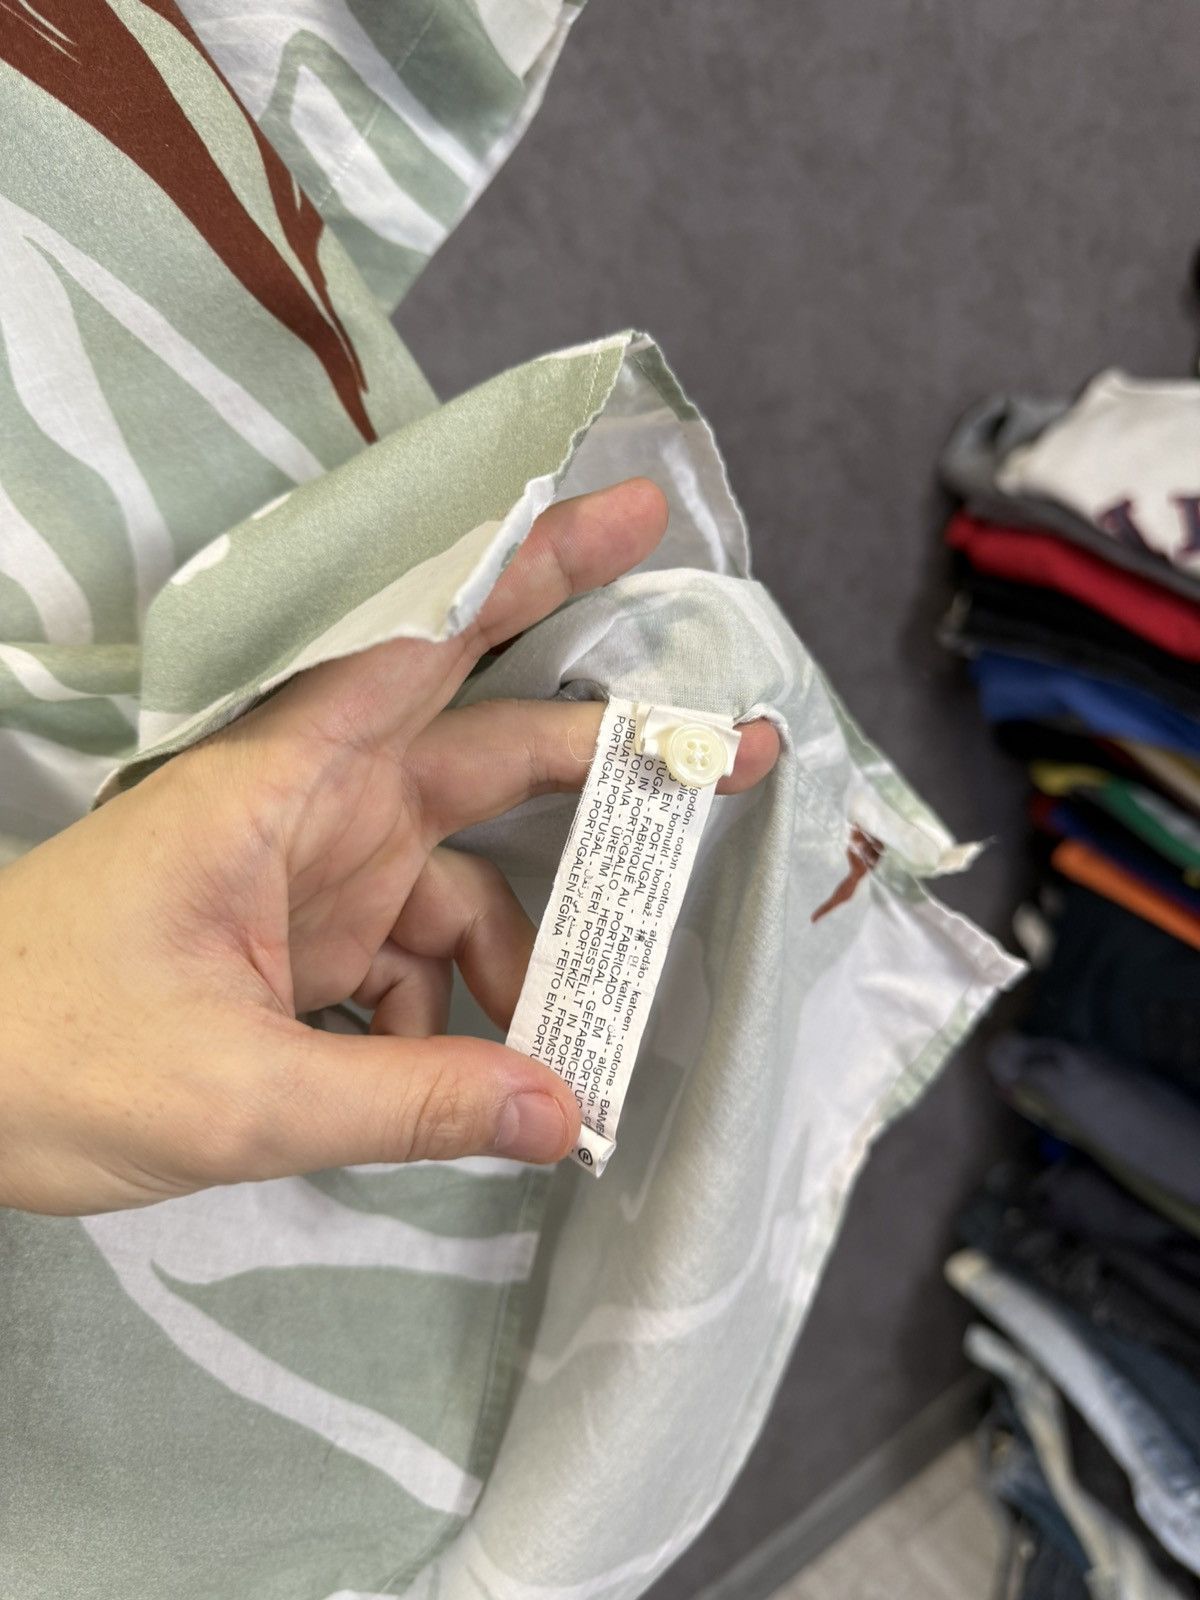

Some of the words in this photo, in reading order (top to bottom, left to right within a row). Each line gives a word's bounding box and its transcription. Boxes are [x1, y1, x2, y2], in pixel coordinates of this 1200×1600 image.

[596, 715, 626, 788] PORTUGAL
[616, 718, 639, 766] DIBUAT
[612, 768, 624, 783] DI
[637, 776, 650, 791] IN
[589, 784, 620, 859] PORTUGAL
[658, 792, 673, 813] EN
[681, 785, 701, 825] lgodón
[565, 798, 602, 893] PORTUGALEN
[598, 825, 625, 878] ÜRETİM
[607, 797, 644, 891] PORTOGALLO
[623, 815, 654, 885] FABRIQUÉ
[659, 812, 681, 858] bomuld
[669, 837, 686, 870] coton
[633, 822, 664, 898] PORTUGAL
[552, 894, 574, 938] EGINA
[586, 882, 606, 915] YERİ
[616, 887, 631, 908] AU
[655, 881, 673, 919] cotton
[549, 949, 570, 990] FEITO
[564, 920, 594, 990] PORTEKİZ
[571, 907, 611, 1009] HERGESTELLT
[592, 910, 624, 988] PORTUGAL
[601, 925, 634, 1007] FABRICADO
[636, 929, 659, 979] algodão
[542, 992, 557, 1013] EN
[613, 979, 632, 1014] katun
[622, 990, 642, 1032] katoen
[529, 1014, 550, 1060] PORTU
[540, 1007, 567, 1069] FREMST
[565, 1013, 578, 1029] IN
[591, 1016, 607, 1039] EM
[551, 1034, 572, 1076] PORT
[606, 1043, 625, 1087] cotone
[570, 1049, 597, 1109] PORTU
[584, 1056, 609, 1107] algodón
